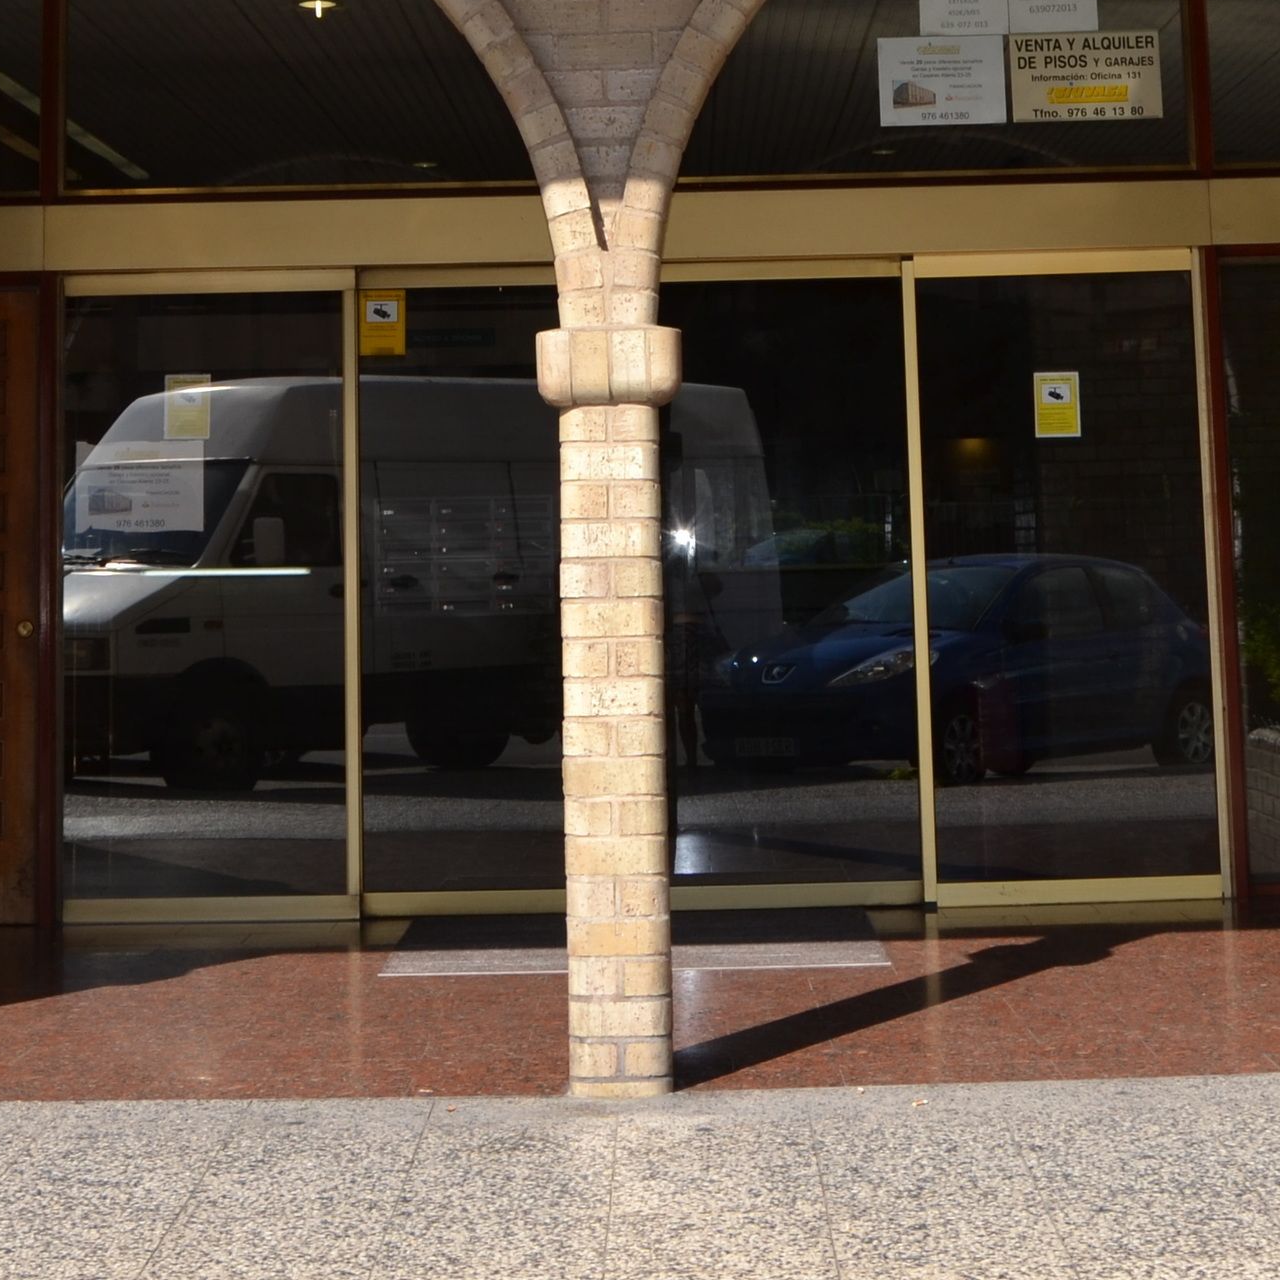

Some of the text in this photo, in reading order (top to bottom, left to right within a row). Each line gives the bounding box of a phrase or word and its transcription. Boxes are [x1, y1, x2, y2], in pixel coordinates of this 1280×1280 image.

[1015, 35, 1155, 53] VENTA Y ALQUILER
[1018, 55, 1155, 70] DE PISOS Y GARAJES
[1031, 71, 1142, 83] Información: Oficina 131
[921, 111, 970, 121] 976 461380
[1033, 106, 1144, 119] Tfno. 976 46 13 80
[116, 520, 132, 528] 976
